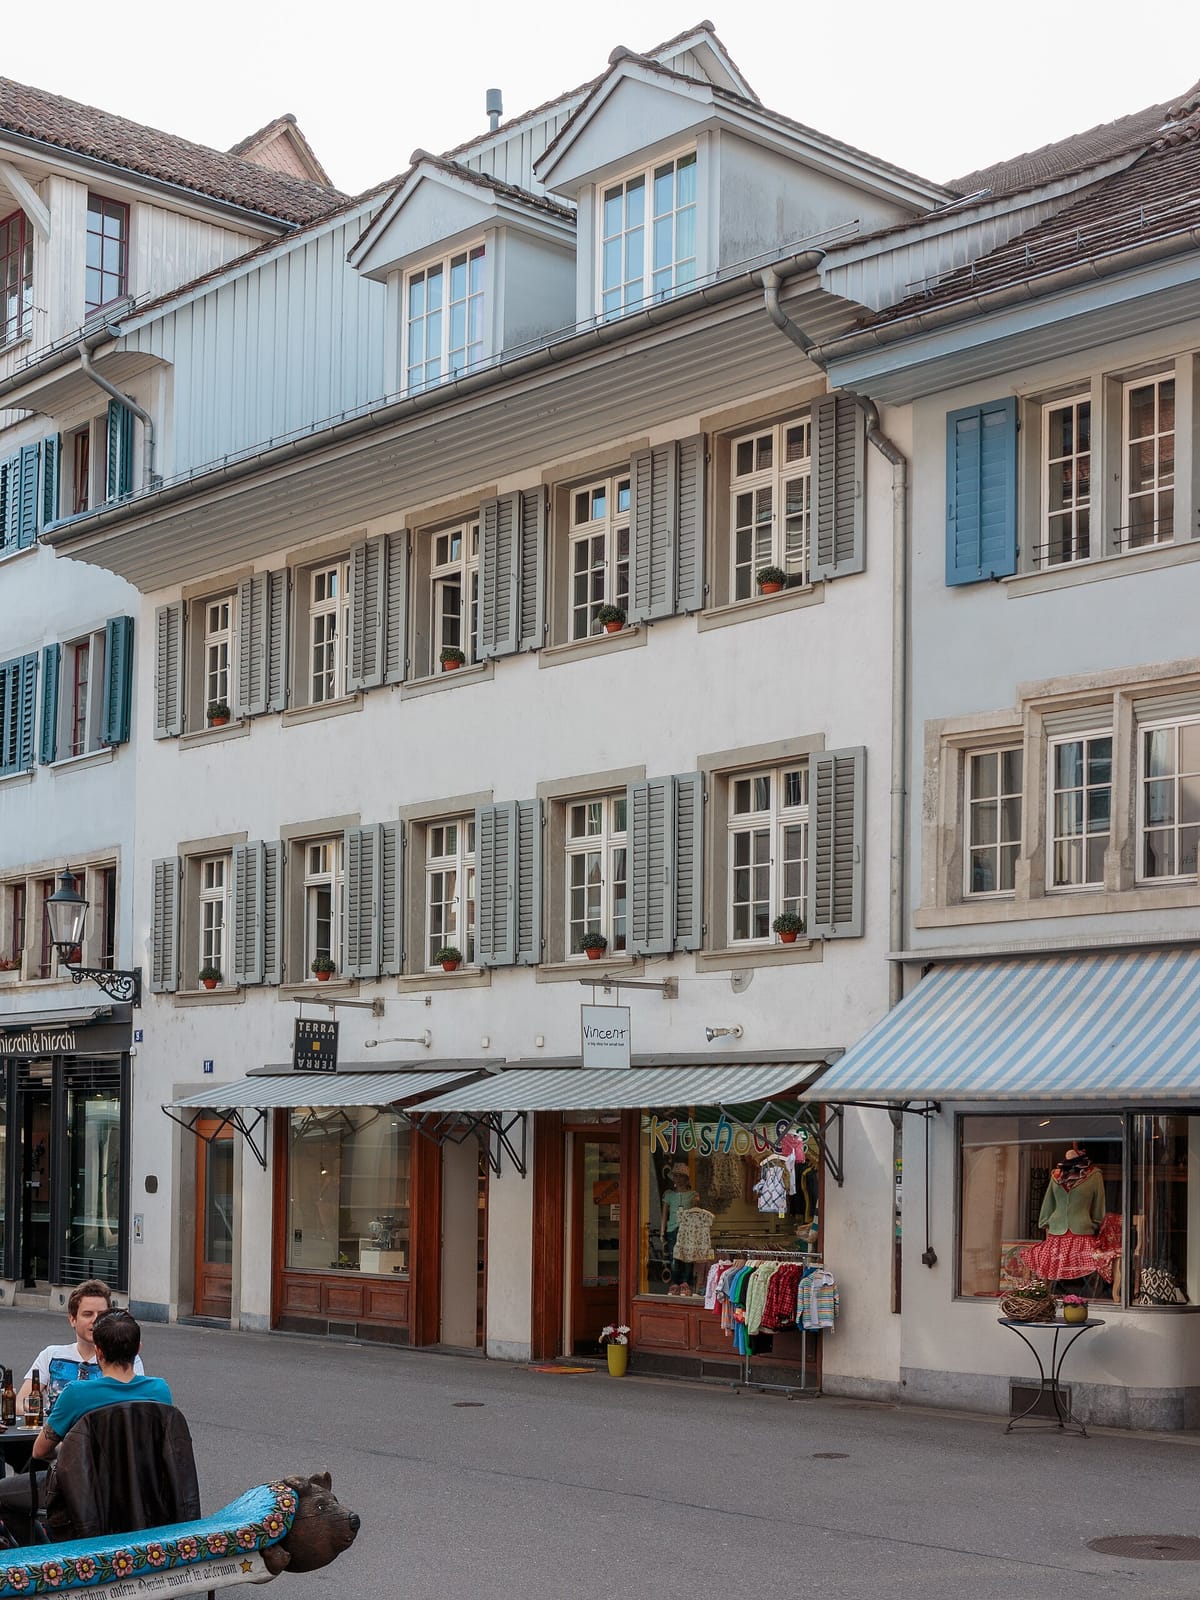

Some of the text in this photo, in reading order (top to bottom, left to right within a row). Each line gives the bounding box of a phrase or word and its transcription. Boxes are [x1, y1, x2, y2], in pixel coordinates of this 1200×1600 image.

[298, 1022, 335, 1033] TERRA
[583, 1025, 629, 1040] Vincent
[297, 1059, 334, 1070] TERRA
